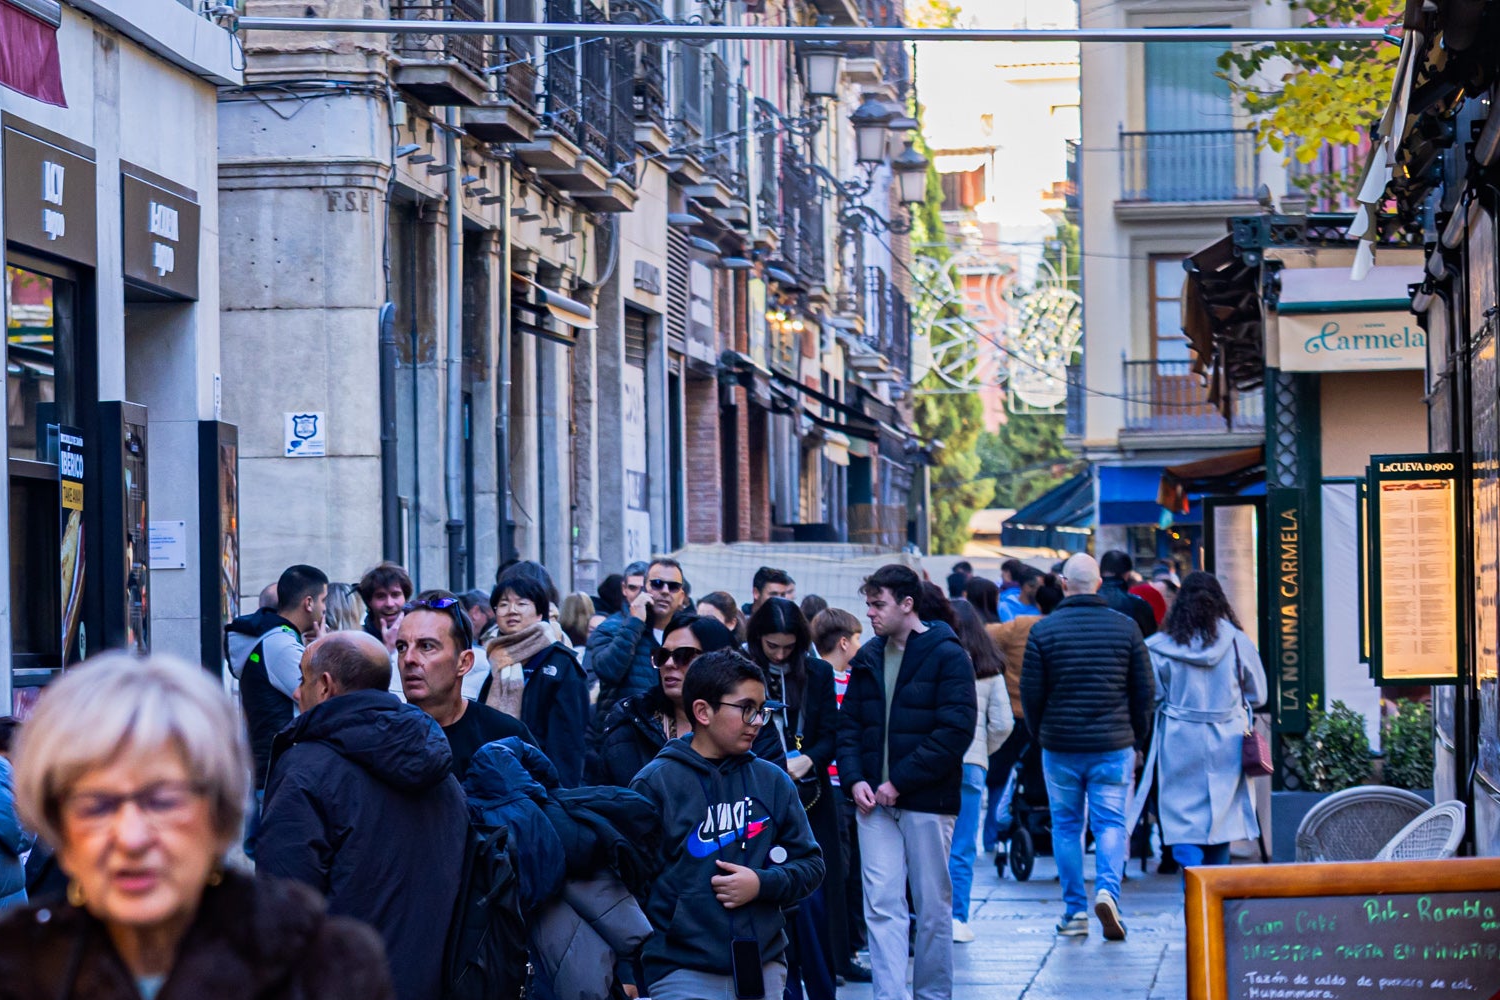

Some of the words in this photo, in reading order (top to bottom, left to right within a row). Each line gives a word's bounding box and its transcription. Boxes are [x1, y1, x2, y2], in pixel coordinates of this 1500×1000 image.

[1304, 321, 1426, 354] Carmela
[1281, 508, 1298, 598] CARMELA
[1281, 603, 1299, 682] NONNA
[1283, 687, 1299, 710] LA
[1293, 974, 1309, 986] de
[1314, 974, 1347, 986] caldo
[1356, 975, 1373, 987] de
